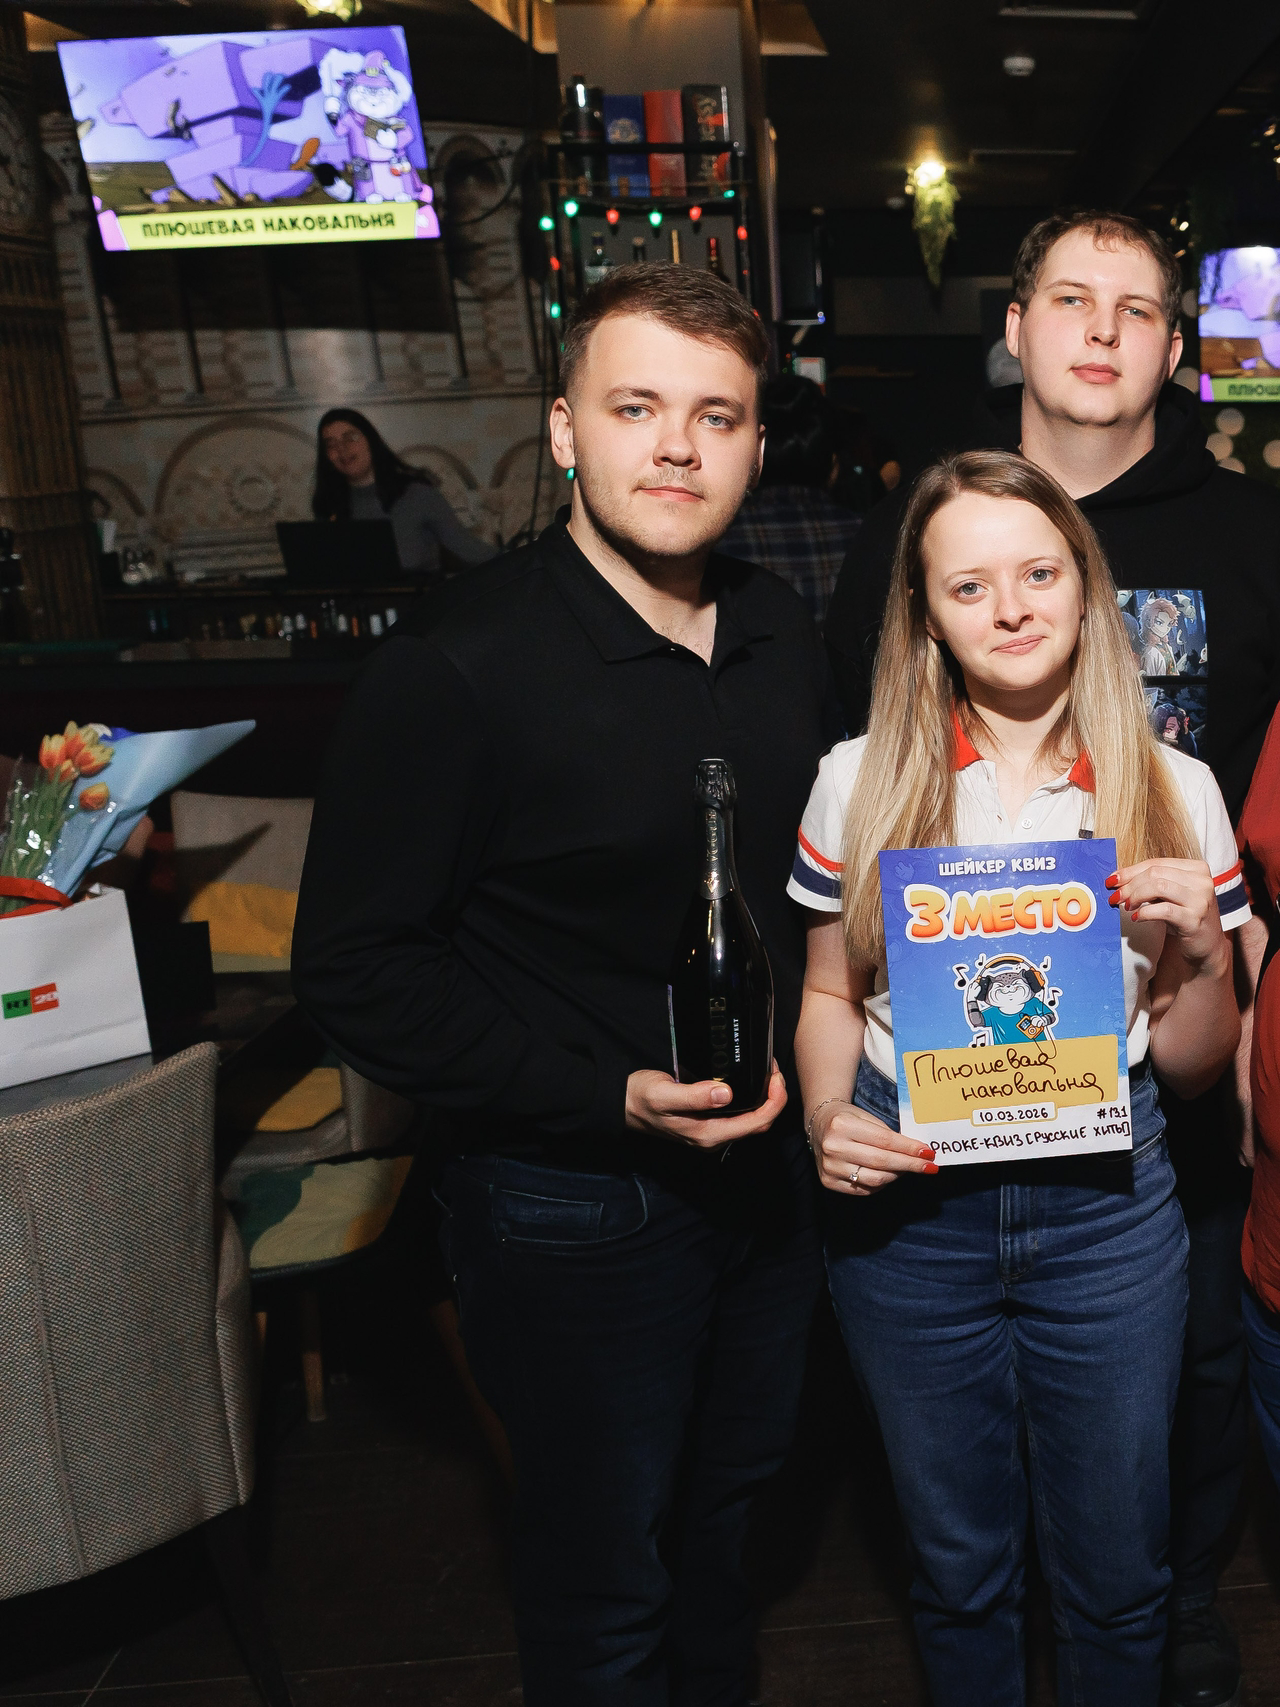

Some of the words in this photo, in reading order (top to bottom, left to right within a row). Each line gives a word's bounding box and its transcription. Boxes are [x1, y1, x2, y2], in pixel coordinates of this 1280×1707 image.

[141, 216, 255, 238] ПЛЮШЕВАЯ
[263, 213, 396, 232] НАКОВАЛЬНЯ
[938, 858, 1006, 877] ШЕЙКЕР
[1011, 856, 1057, 872] КВИЗ
[907, 887, 948, 940] 3
[951, 885, 1094, 937] МЕСТО
[914, 1048, 1056, 1087] Плюшевая
[961, 1072, 1105, 1102] наковальня
[979, 1107, 1049, 1123] 10.03.2026
[930, 1134, 1024, 1154] РАОКЕ-КВИЗ
